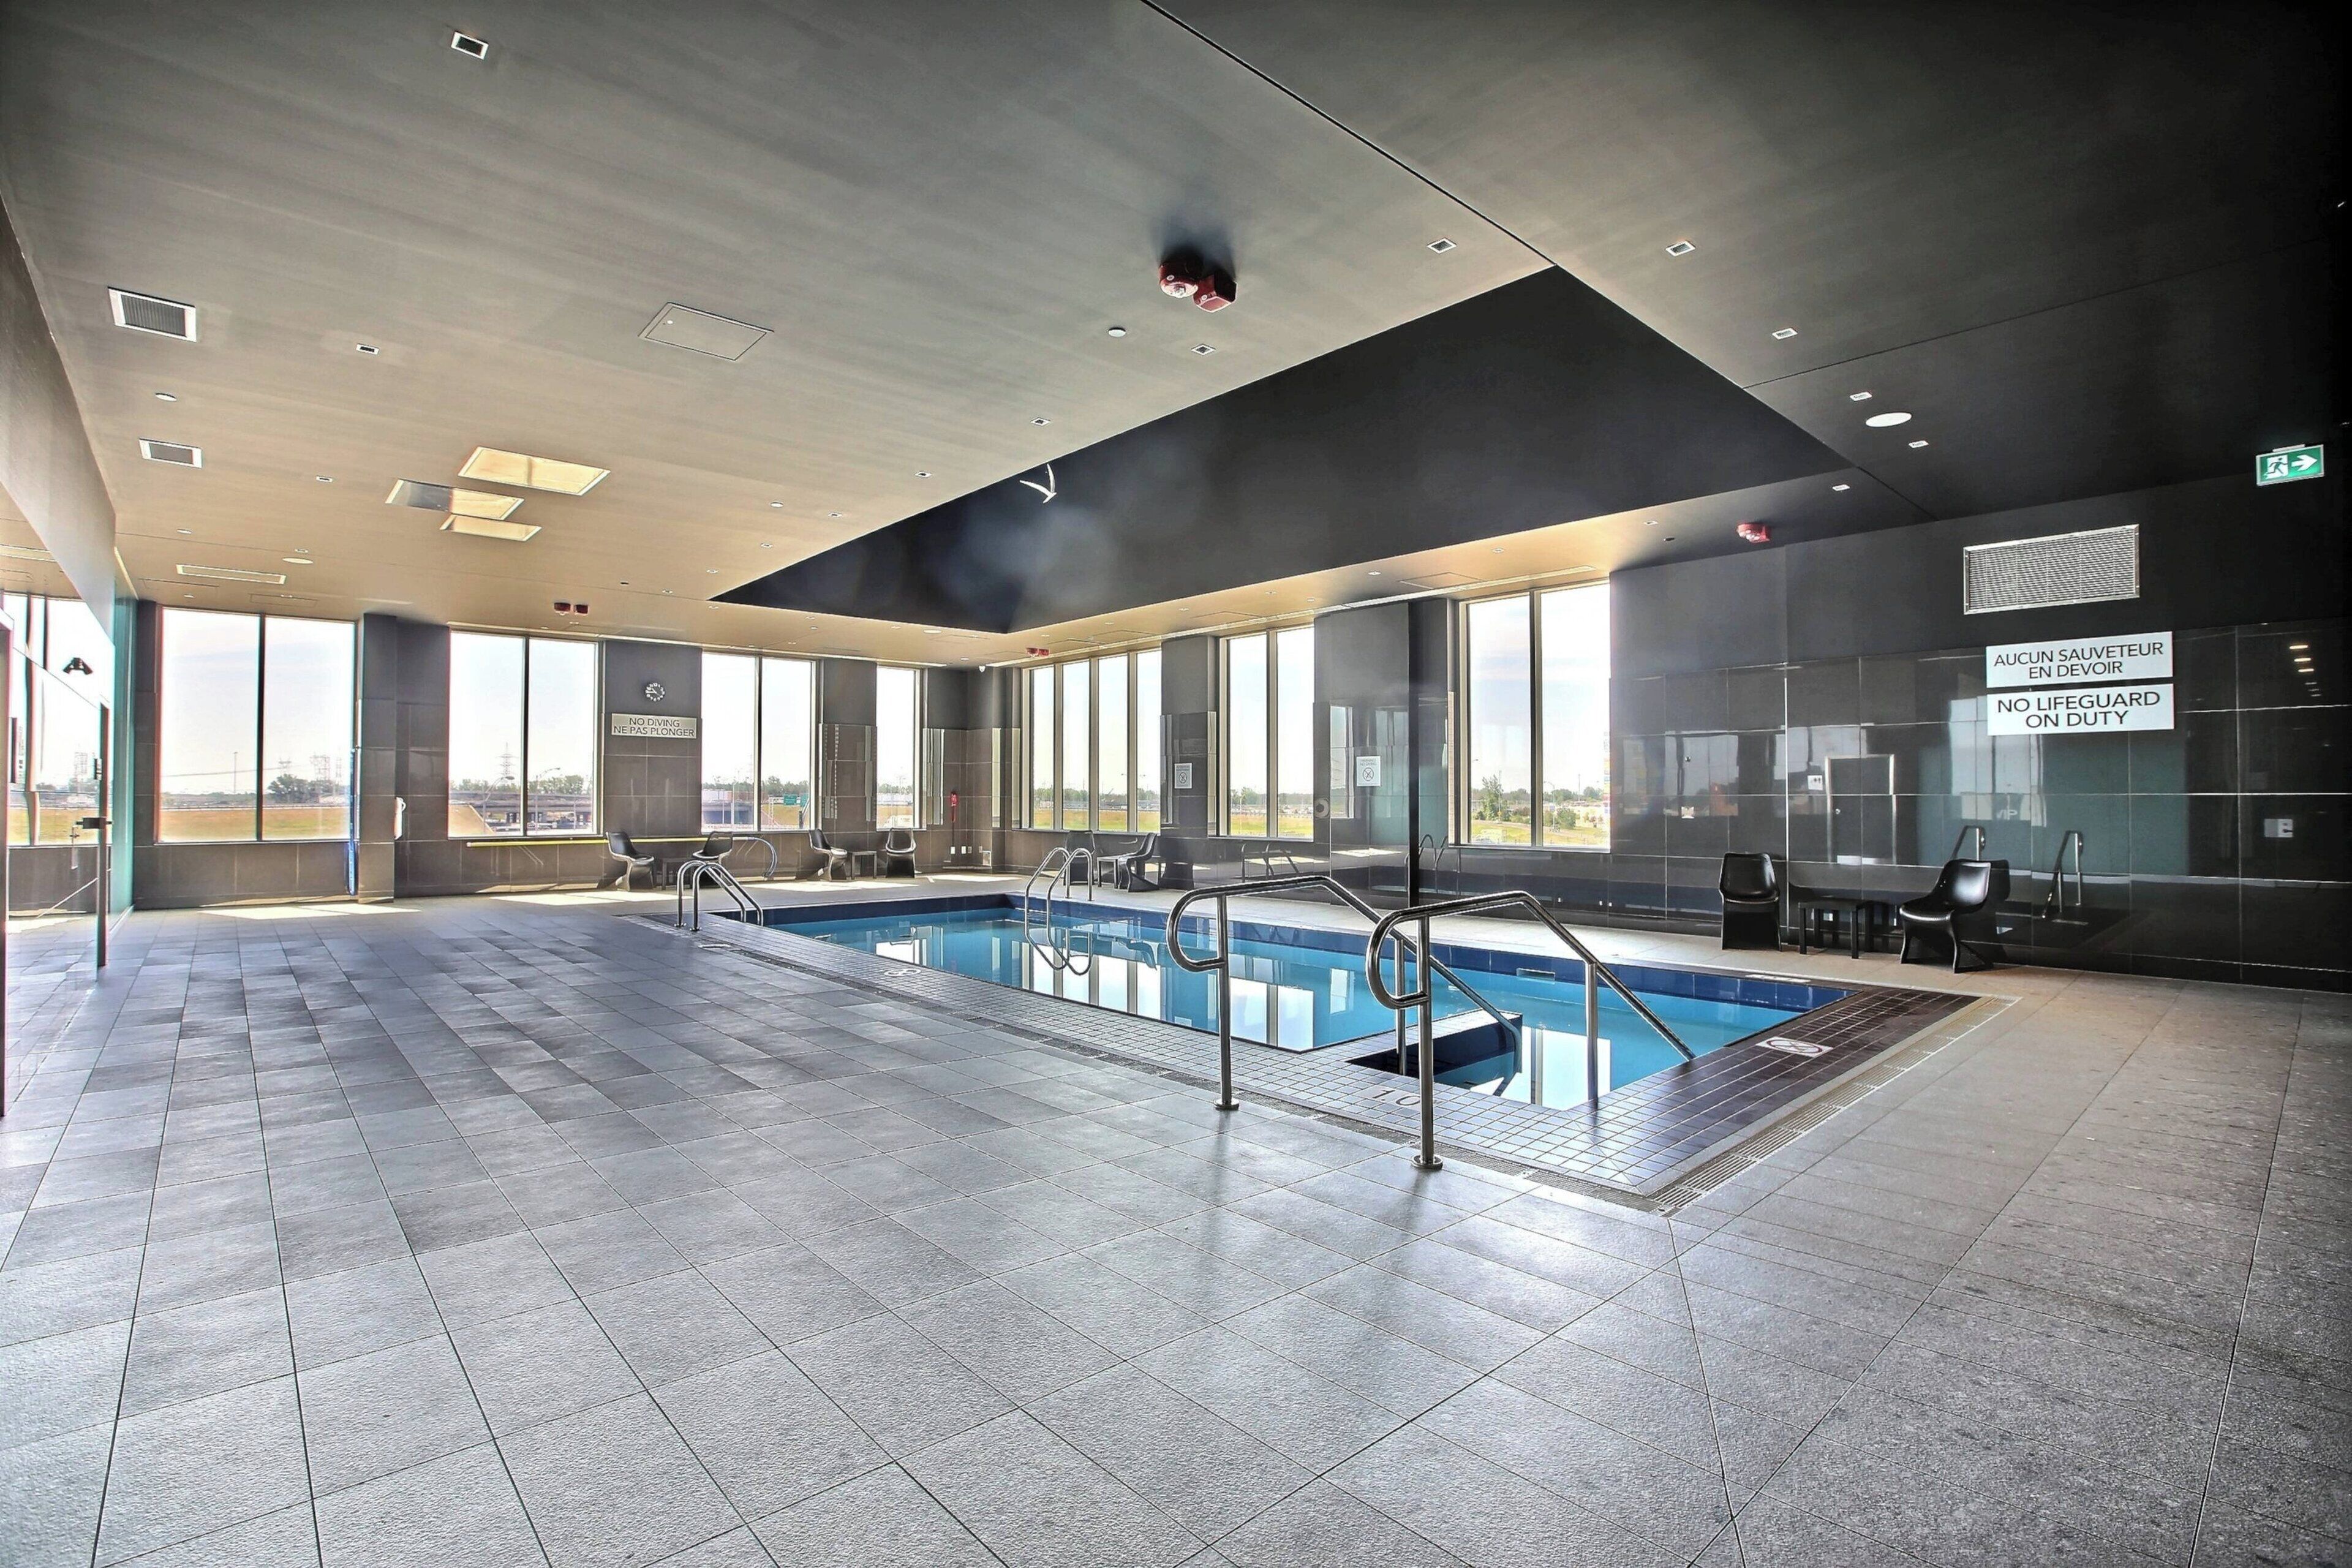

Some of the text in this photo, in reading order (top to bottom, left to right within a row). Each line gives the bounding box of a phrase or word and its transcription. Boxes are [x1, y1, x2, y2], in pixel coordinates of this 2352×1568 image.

[1994, 643, 2163, 666] AUCUN SAUVETEUR
[2029, 661, 2123, 679] EN DEVOIR
[1998, 692, 2161, 713] NO LIFEGUARD
[629, 717, 680, 728] NO DIVING
[2026, 710, 2129, 728] ON DUTY
[630, 726, 647, 735] PAS
[650, 727, 695, 737] PLONGER
